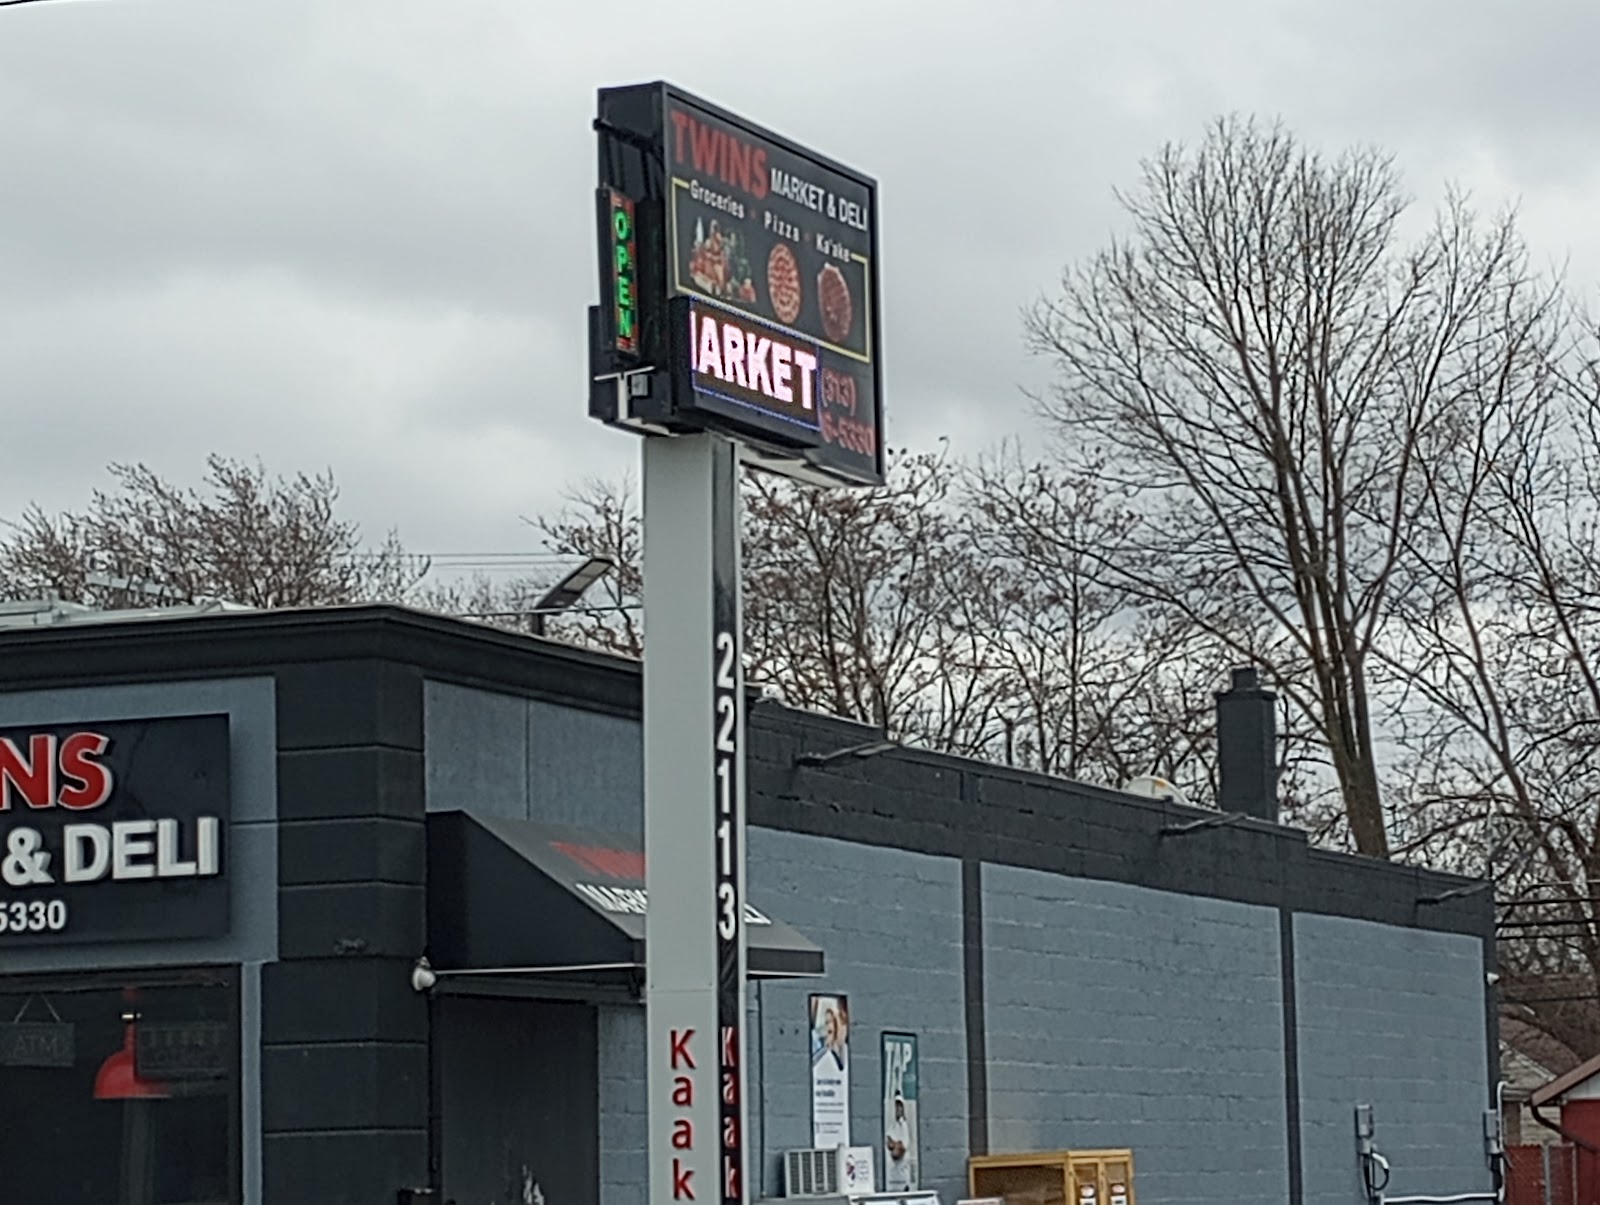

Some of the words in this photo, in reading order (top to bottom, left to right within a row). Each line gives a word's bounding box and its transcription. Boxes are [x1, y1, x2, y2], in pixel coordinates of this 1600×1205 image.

[671, 110, 769, 200] TWINS
[771, 168, 825, 214] MARKET
[827, 192, 836, 218] &
[838, 198, 868, 231] DELI
[689, 179, 745, 219] Groceries
[764, 212, 801, 242] Pizza
[614, 210, 632, 338] OPEN
[0, 732, 112, 810] NS
[716, 631, 736, 940] 22113
[2, 827, 55, 886] &
[64, 816, 219, 882] DELI
[670, 1029, 697, 1201] Kaak
[721, 1026, 737, 1198] Kaak
